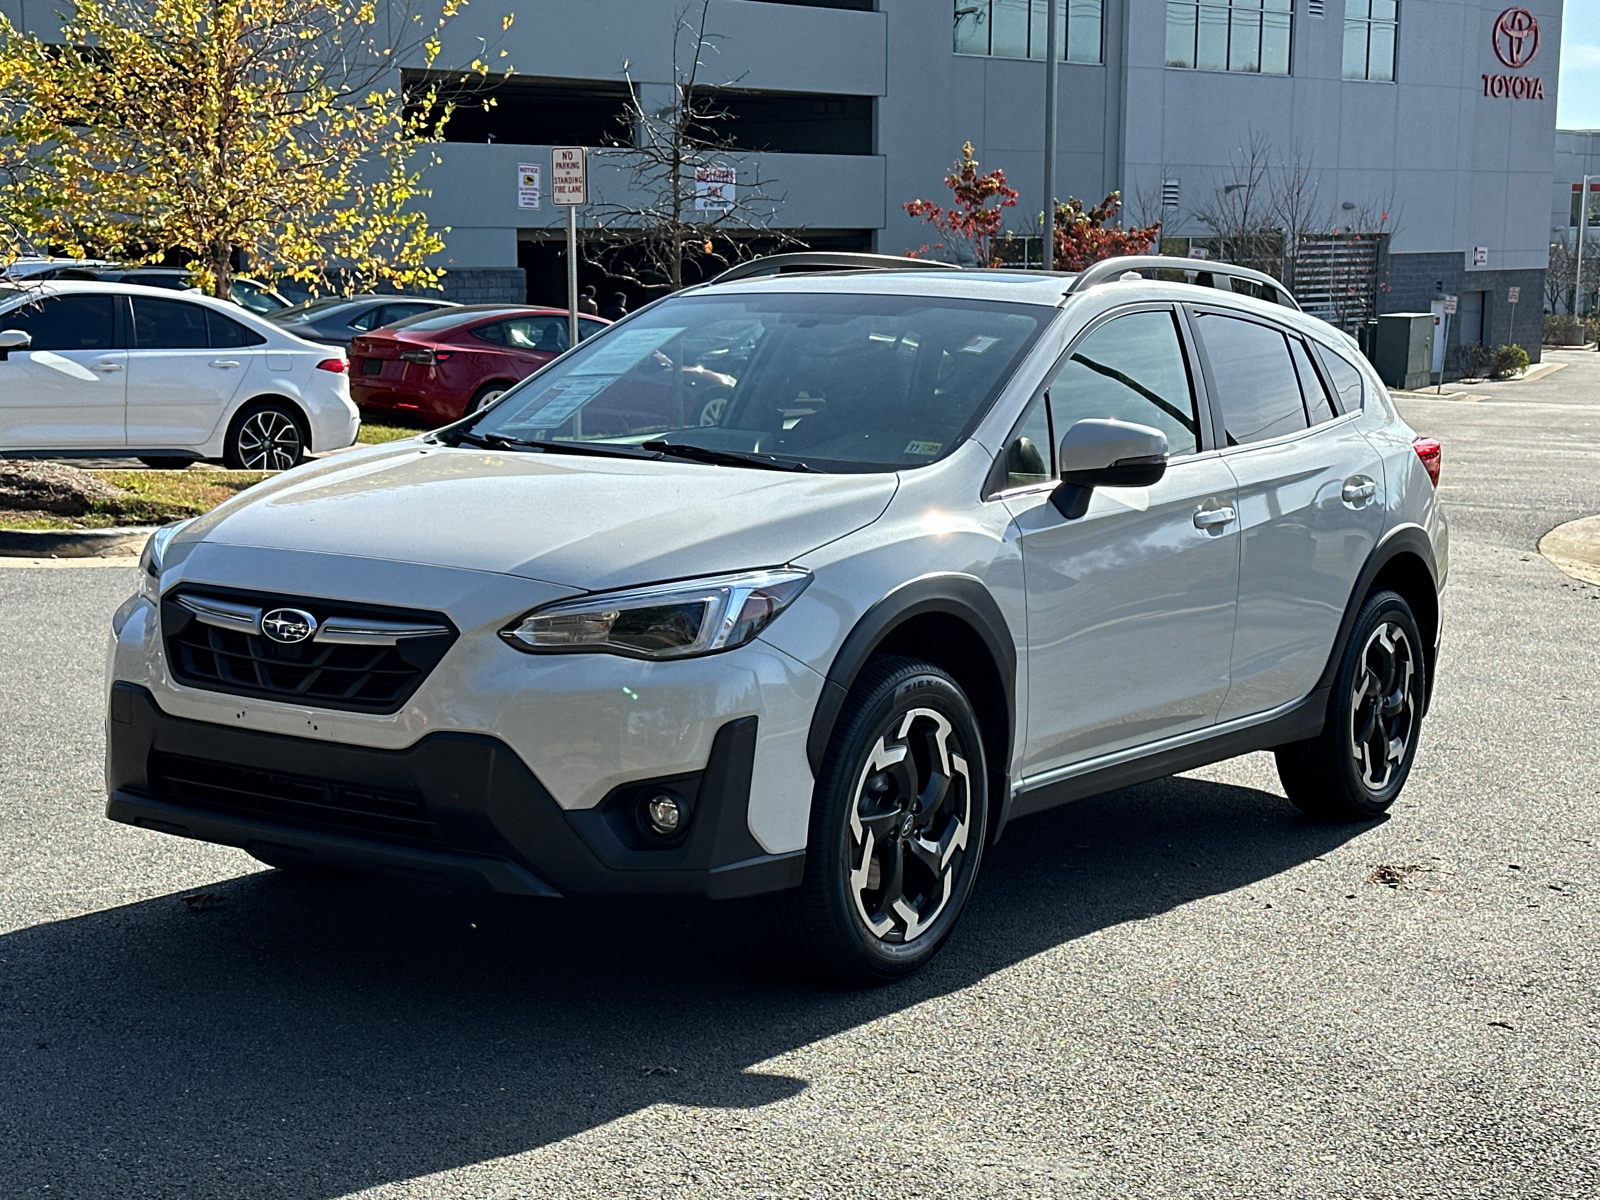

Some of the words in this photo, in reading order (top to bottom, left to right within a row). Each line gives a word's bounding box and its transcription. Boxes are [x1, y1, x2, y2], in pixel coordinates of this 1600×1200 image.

[1482, 74, 1545, 99] TOYOTA
[562, 151, 573, 160] NO
[909, 444, 919, 452] 11
[904, 680, 933, 694] ZIEX
